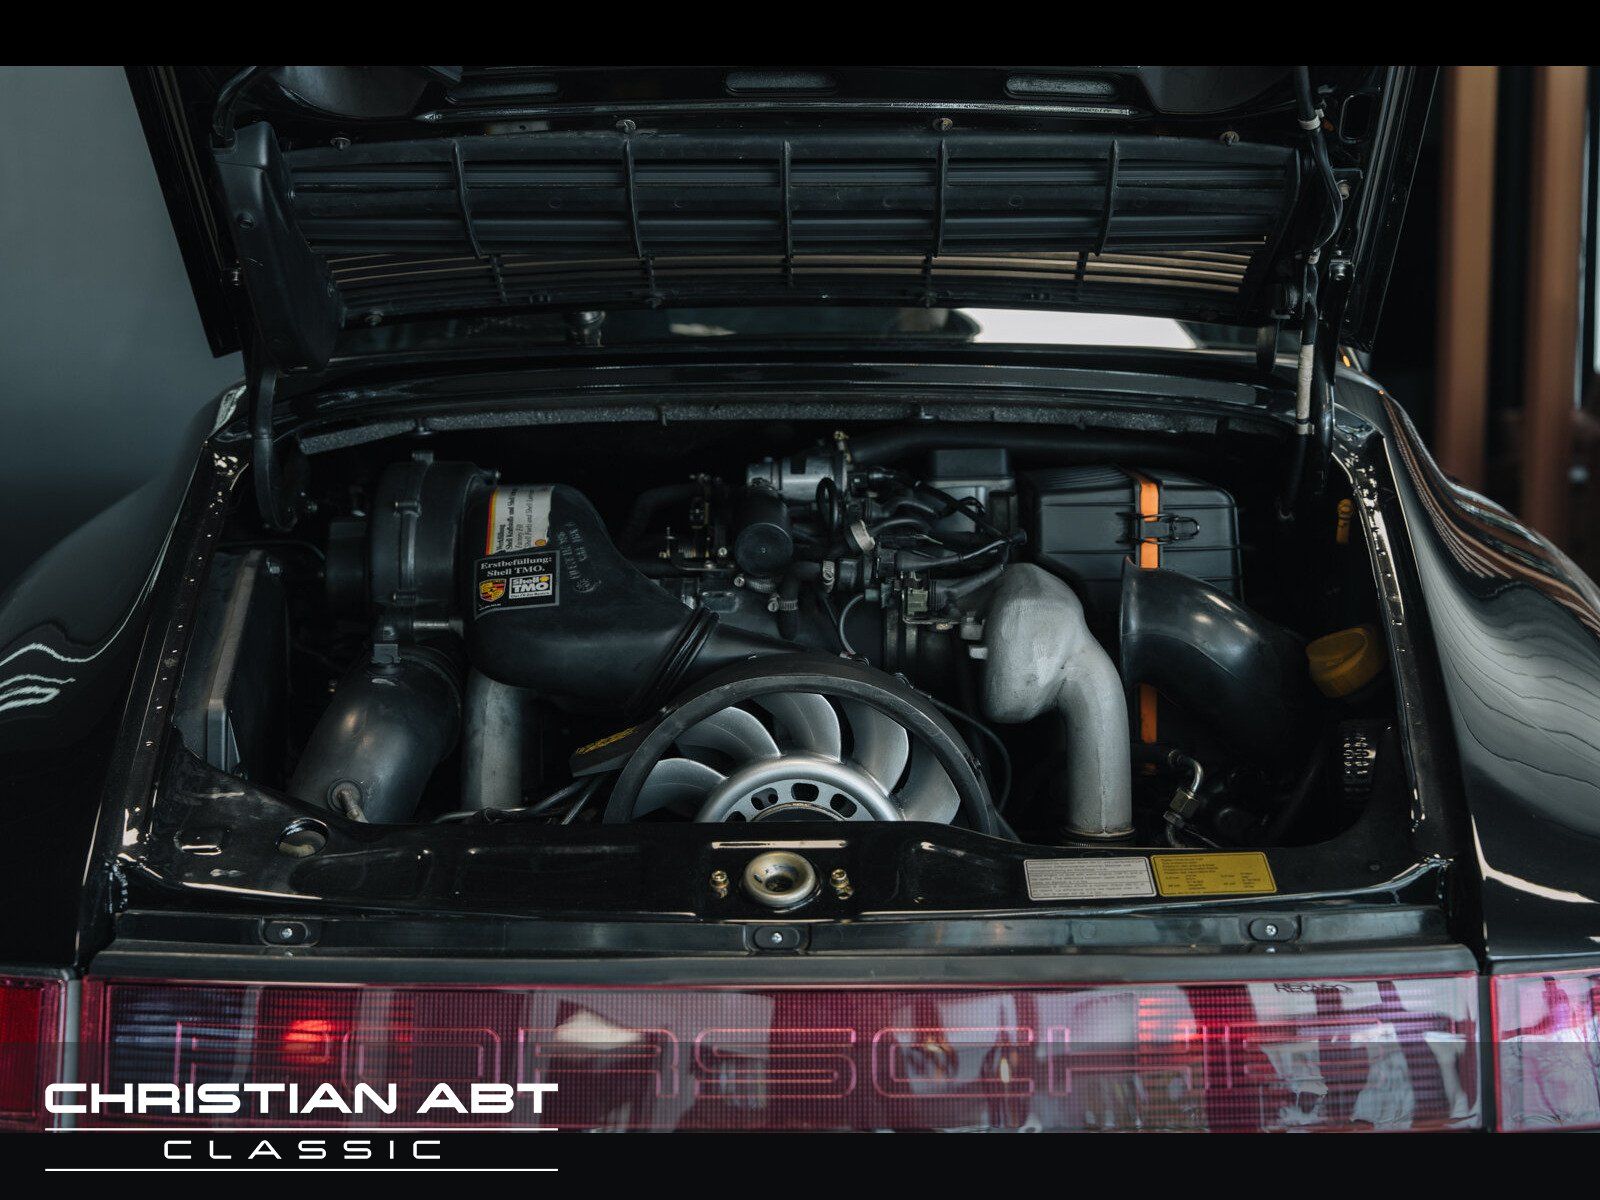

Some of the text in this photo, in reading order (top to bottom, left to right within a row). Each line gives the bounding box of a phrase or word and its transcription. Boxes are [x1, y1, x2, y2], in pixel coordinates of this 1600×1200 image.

[487, 565, 545, 577] Shell TMO.
[512, 576, 540, 585] Shell
[512, 582, 549, 593] TMO
[174, 1018, 1384, 1099] PORSCHE
